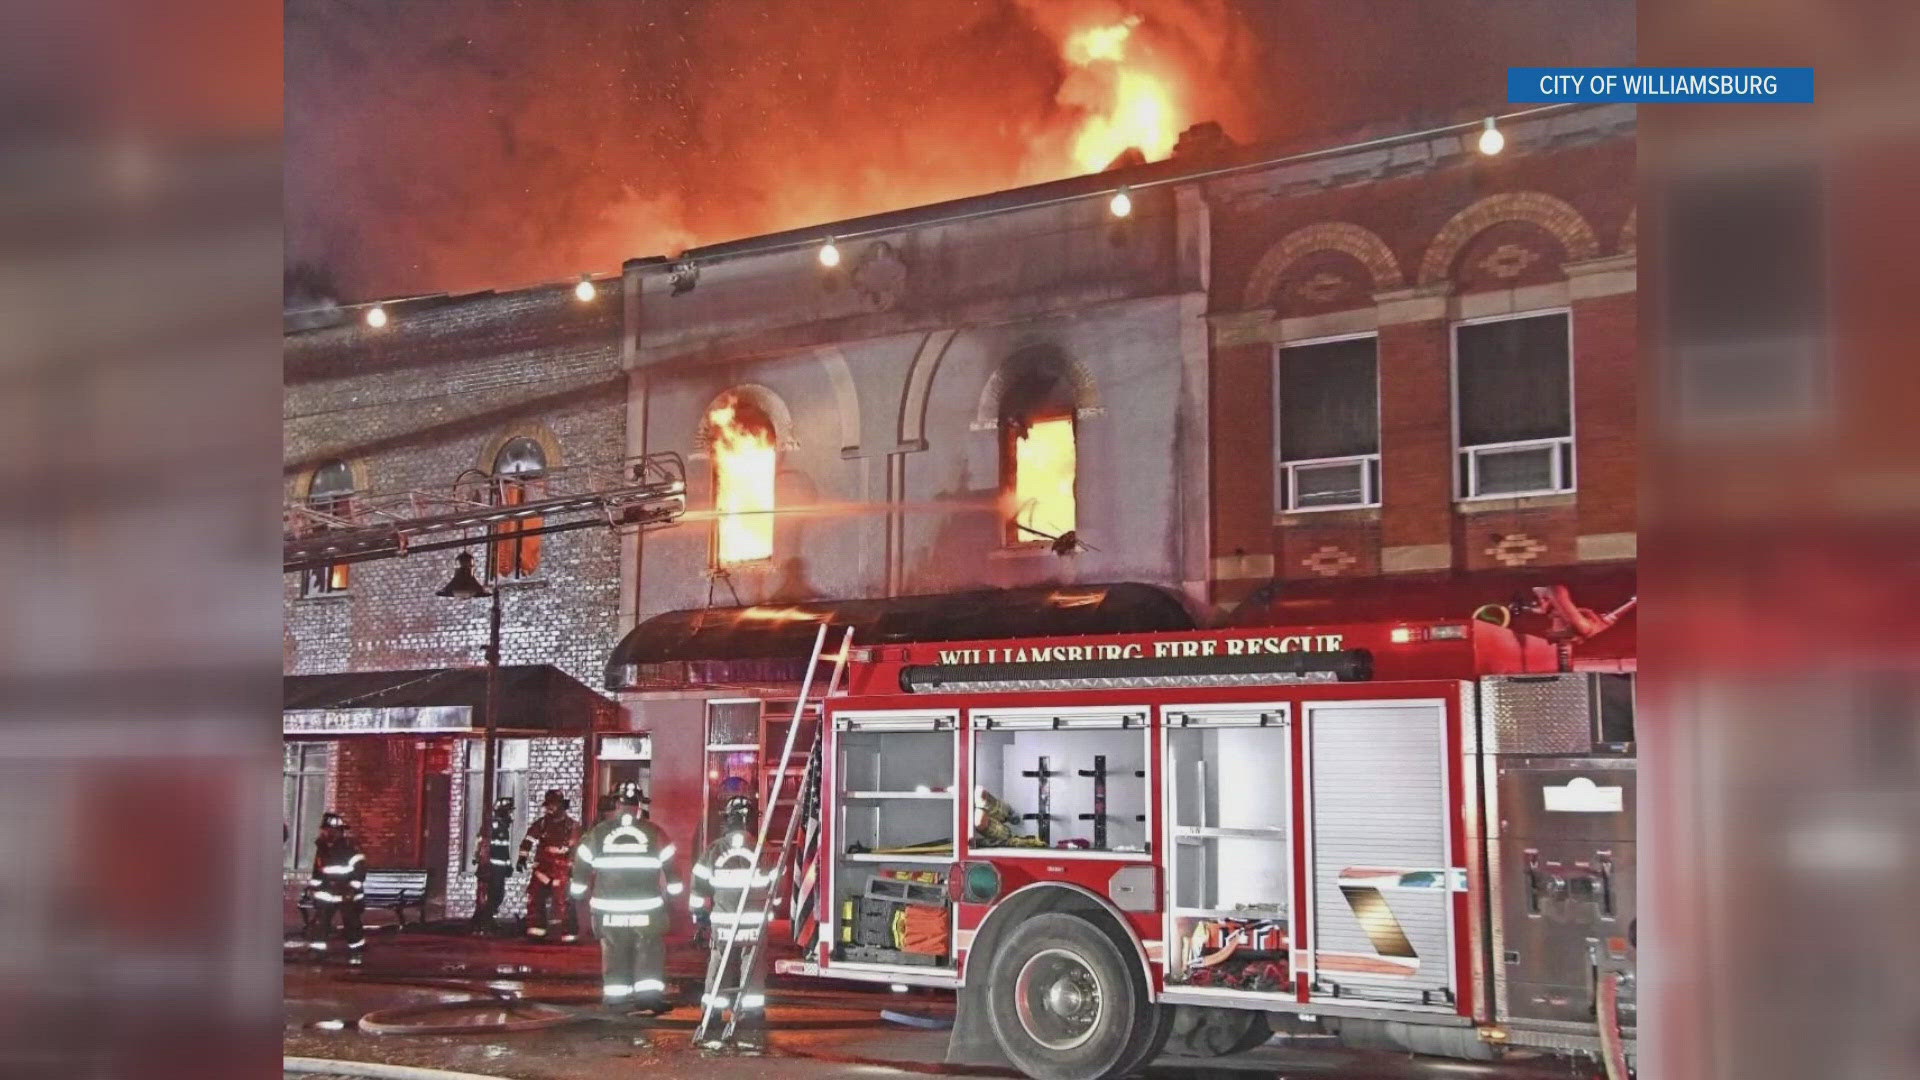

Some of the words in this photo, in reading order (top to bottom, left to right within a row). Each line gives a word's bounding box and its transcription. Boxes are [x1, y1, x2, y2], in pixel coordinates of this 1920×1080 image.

[938, 643, 1144, 666] WILLIAMSBURG
[1153, 640, 1217, 658] FIRE
[1225, 634, 1344, 656] RESCUE
